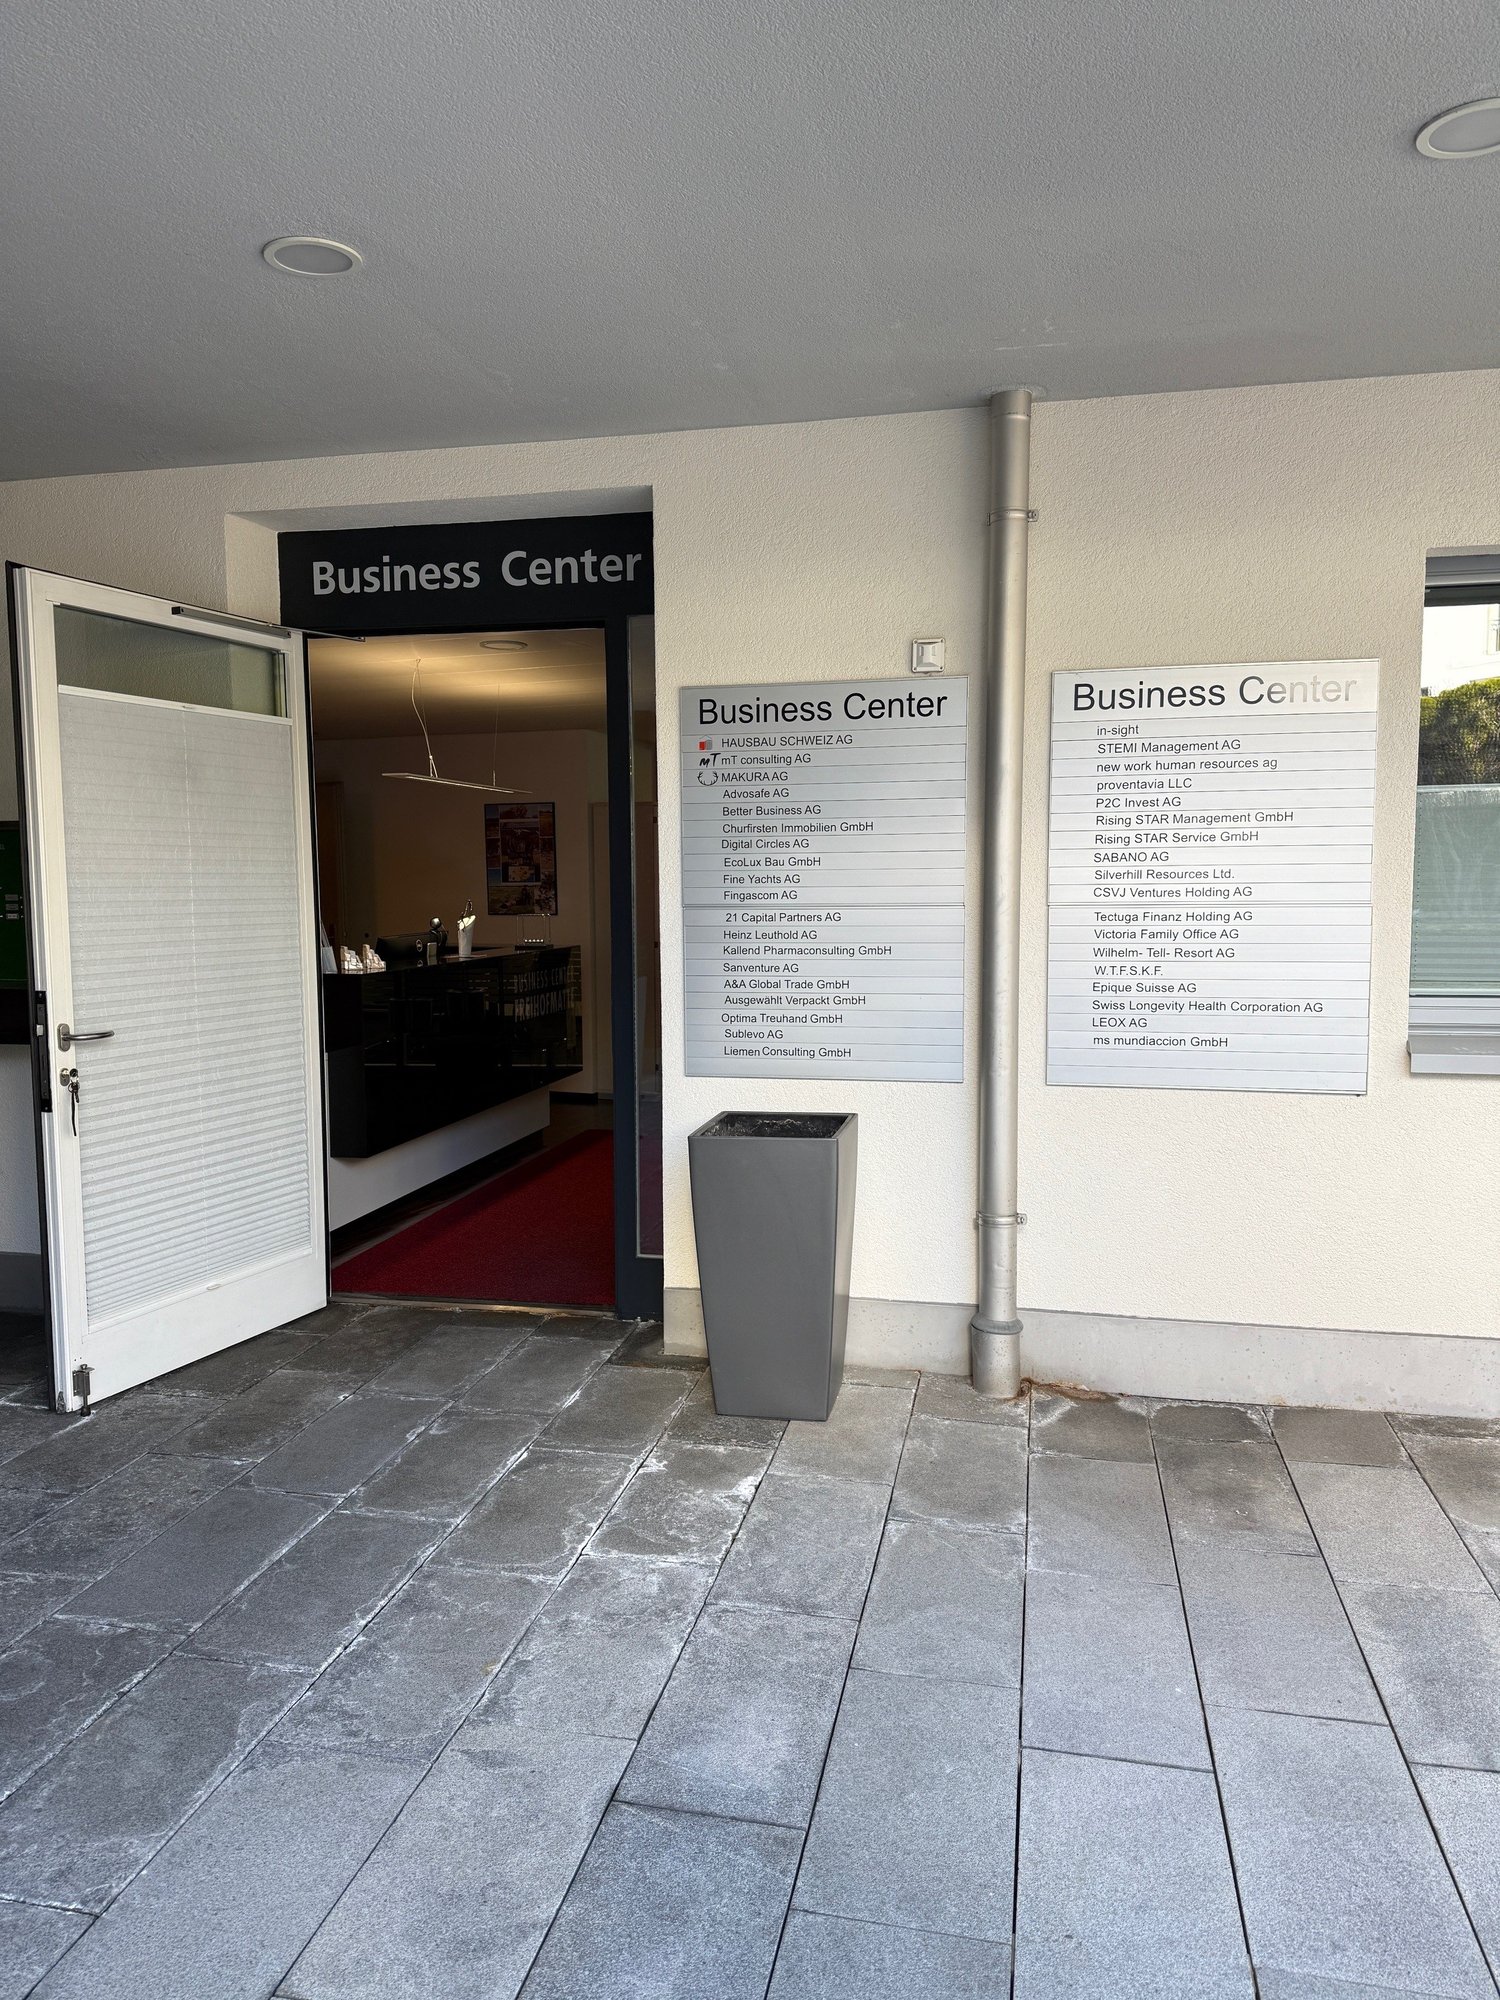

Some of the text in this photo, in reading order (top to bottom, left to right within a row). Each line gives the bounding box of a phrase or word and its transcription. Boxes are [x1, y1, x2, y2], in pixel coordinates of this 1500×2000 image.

[313, 548, 642, 595] Business Center
[1073, 675, 1357, 711] Business Center
[699, 691, 947, 725] Business Center
[1096, 724, 1139, 737] in-sight
[722, 734, 853, 748] HAUSBAU SCHWEIZ AG
[1097, 740, 1241, 754] STEMI Management AG
[721, 754, 811, 766] mT consulting AG
[1096, 758, 1278, 772] new work human resources ag
[722, 771, 788, 782] MAKURA AG
[1097, 778, 1193, 792] proventavia LLC
[723, 788, 789, 799] Advosafe AG
[1096, 797, 1181, 809] P2C Invest AG
[722, 805, 821, 816] Better Business AG
[1096, 811, 1294, 827] Rising STAR Management GmbH
[722, 821, 873, 833] Churfirsten Immobilien GmbH
[1095, 831, 1259, 846] Rising STAR Service GmbH
[721, 839, 810, 851] Digital Circles AG
[724, 856, 821, 867] EcoLux Bau GmbH
[1094, 851, 1169, 863] SABANO AG
[723, 874, 800, 884] Fine Yachts AG
[1095, 868, 1235, 880] Silverhill Resources Ltd.
[724, 890, 798, 903] Fingascom AG
[1093, 887, 1253, 899] CSVJ Ventures Holding AG
[726, 912, 841, 924] 21 Capital Partners AG
[1094, 911, 1253, 924] Tectuga Finanz Holding AG
[723, 930, 817, 940] Heinz Leuthold AG
[1094, 929, 1239, 941] Victoria Family Office AG
[723, 945, 892, 957] Kallend Pharmaconsulting GmbH
[1093, 947, 1235, 958] Wilhelm- Tell- Resort AG
[723, 963, 799, 973] Sanventure AG
[1094, 965, 1163, 976] W.T.F.S.K.F.
[724, 979, 850, 990] A&A Global Trade GmbH
[1092, 982, 1197, 995] Epique Suisse AG
[724, 995, 866, 1007] Ausgewählt Verpackt GmbH
[1092, 1000, 1323, 1014] Swiss Longevity Health Corporation AG
[721, 1013, 843, 1025] Optima Treuhand GmbH
[1092, 1018, 1147, 1028] LEOX AG
[724, 1029, 783, 1039] Sublevo AG
[1093, 1036, 1228, 1048] ms mundiaccion GmbH
[724, 1046, 851, 1059] Liemen Consulting GmbH
